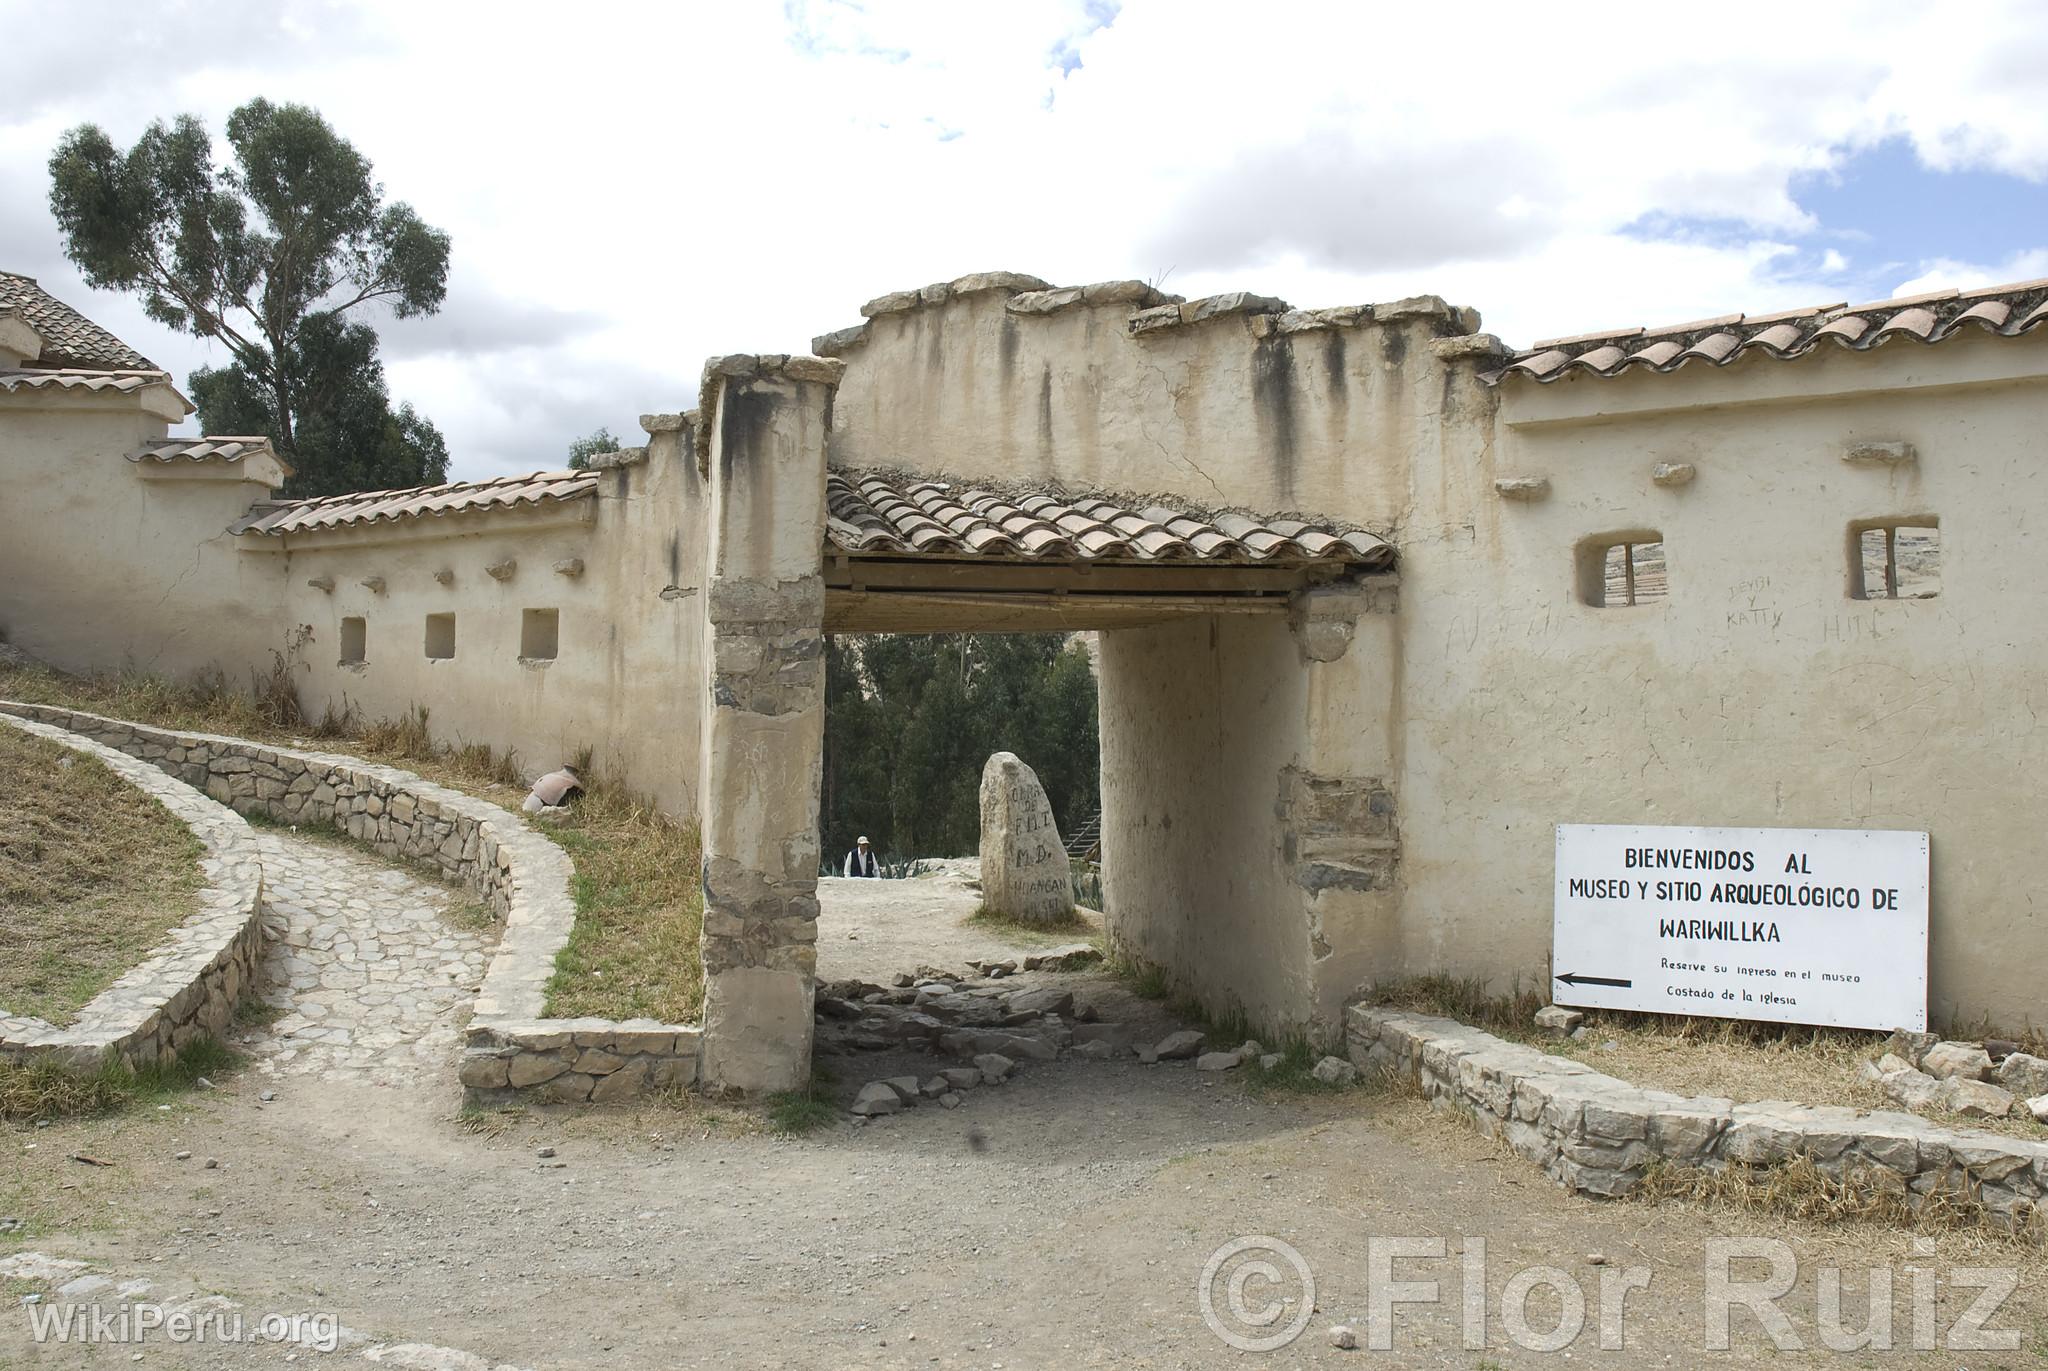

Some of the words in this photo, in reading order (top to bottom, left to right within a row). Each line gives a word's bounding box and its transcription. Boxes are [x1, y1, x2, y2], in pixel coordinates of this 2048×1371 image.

[1624, 847, 1755, 872] BIENVENIDOS
[1784, 853, 1812, 875] AL
[1569, 878, 1630, 899] MUSEO
[1637, 880, 1648, 900] Y
[1656, 881, 1702, 902] SITIO
[1710, 881, 1860, 909] ARQUEOLÓGICO
[1872, 888, 1899, 911] DE
[1659, 918, 1781, 943] WARIWILLKA
[1661, 957, 1706, 972] Reserve
[1714, 965, 1728, 973] su
[1784, 970, 1797, 978] en
[1801, 970, 1811, 979] el
[1822, 973, 1860, 983] museo
[1666, 985, 1714, 999] Costado
[1721, 988, 1735, 1000] de
[1742, 988, 1753, 1002] la
